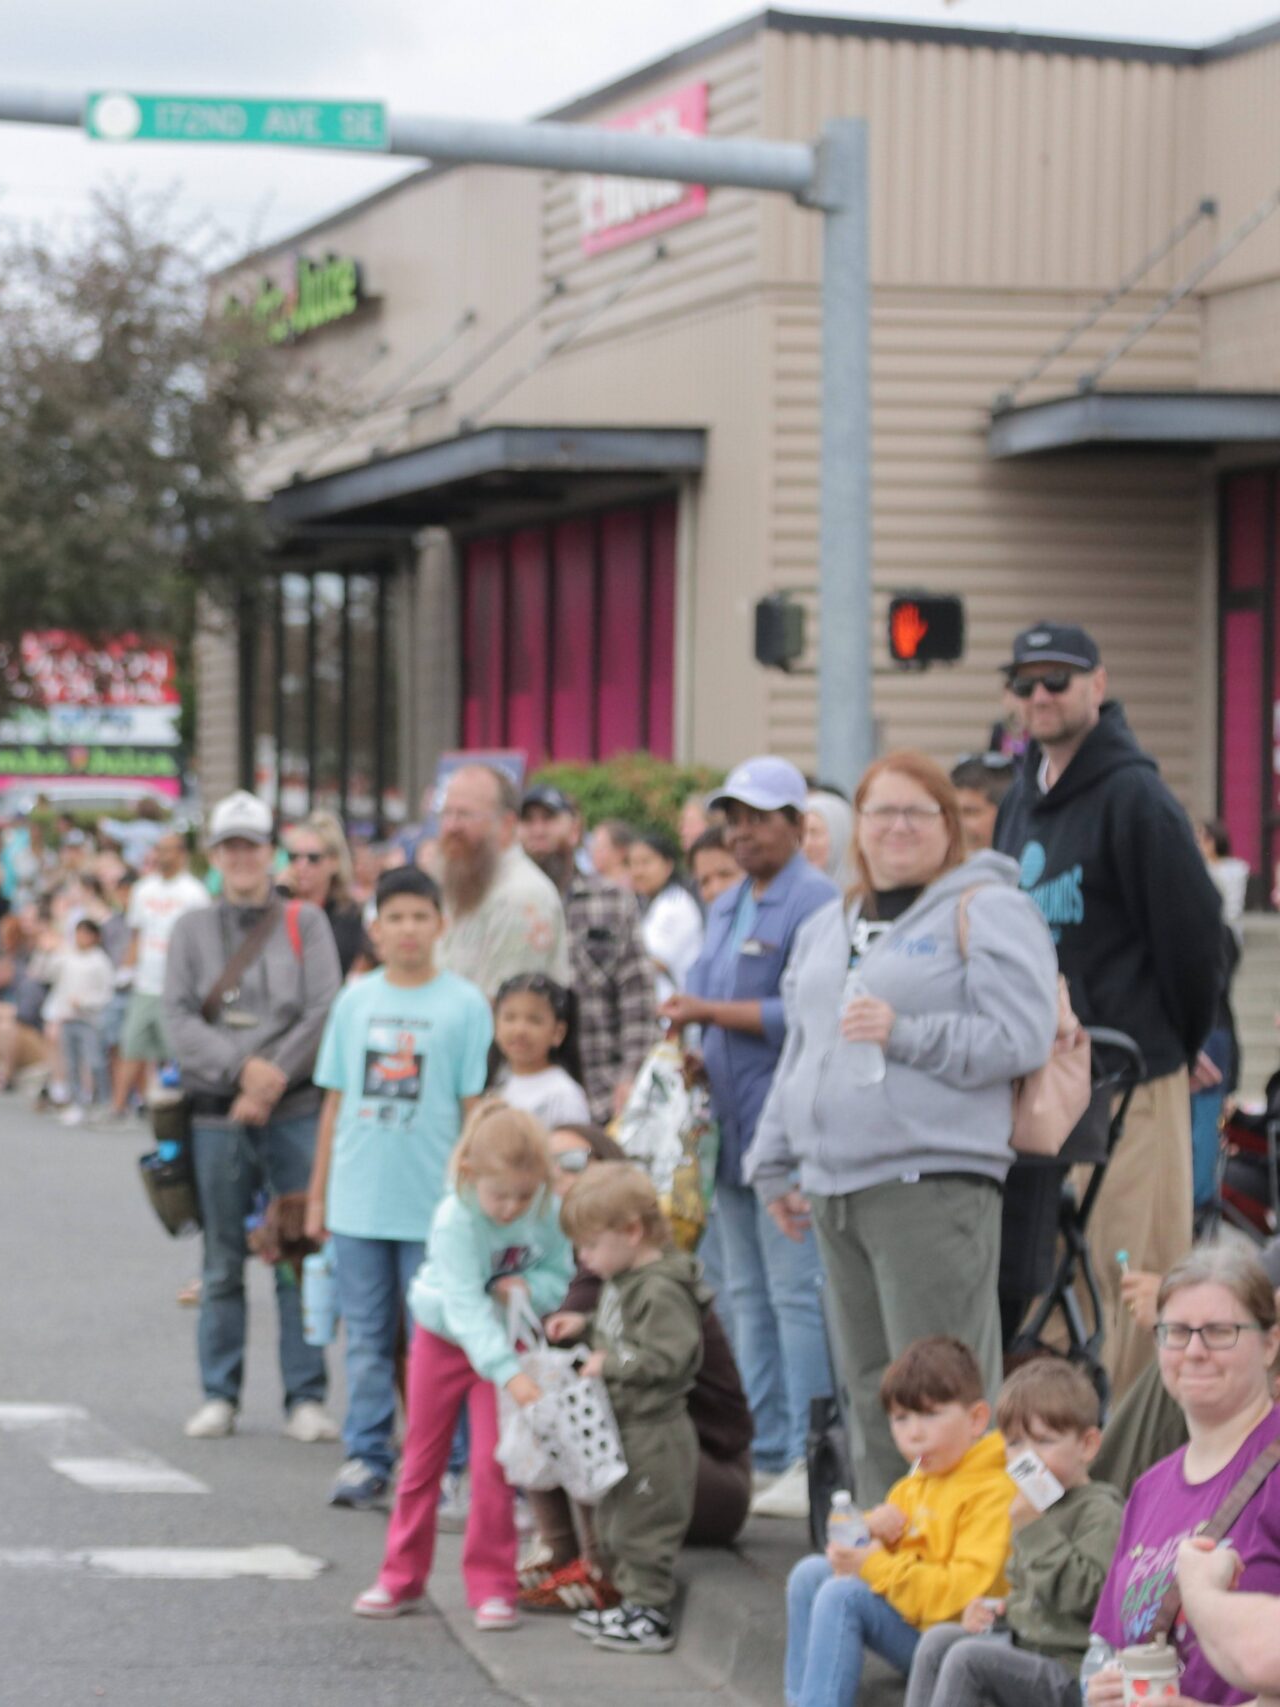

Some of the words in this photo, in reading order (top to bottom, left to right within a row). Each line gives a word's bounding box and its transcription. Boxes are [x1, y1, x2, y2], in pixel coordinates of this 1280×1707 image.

[154, 102, 248, 137] 172ND
[260, 105, 323, 139] AVE
[339, 107, 377, 141] SE
